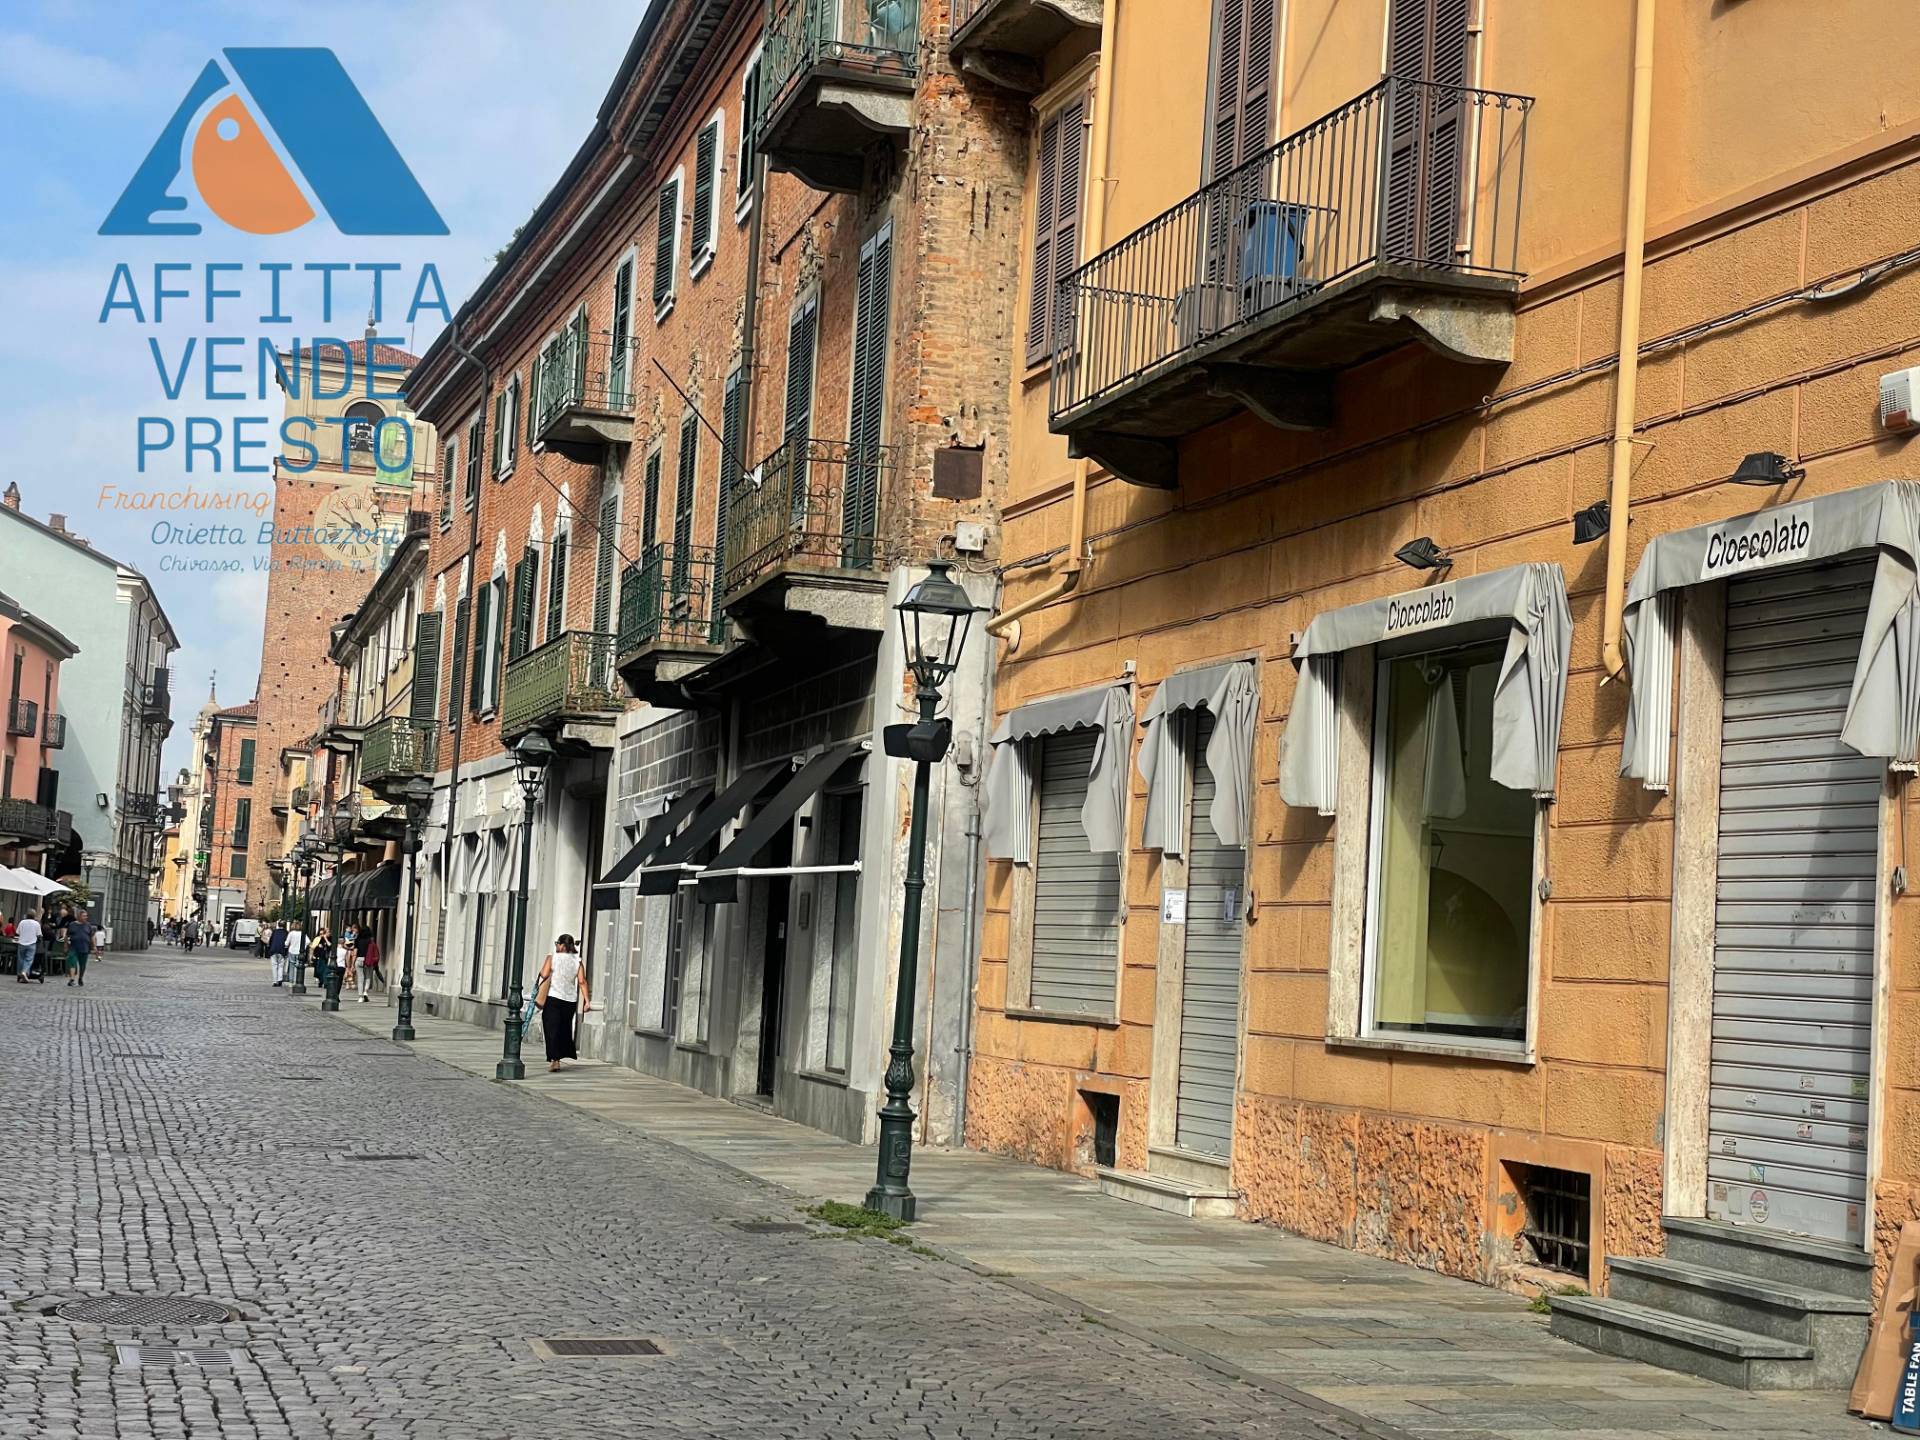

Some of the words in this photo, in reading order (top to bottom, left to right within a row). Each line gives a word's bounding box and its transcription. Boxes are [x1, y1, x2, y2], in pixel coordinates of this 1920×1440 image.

[1388, 590, 1454, 630] Cioccolato
[1909, 1342, 1920, 1369] FAN
[1902, 1372, 1918, 1414] TABLE
